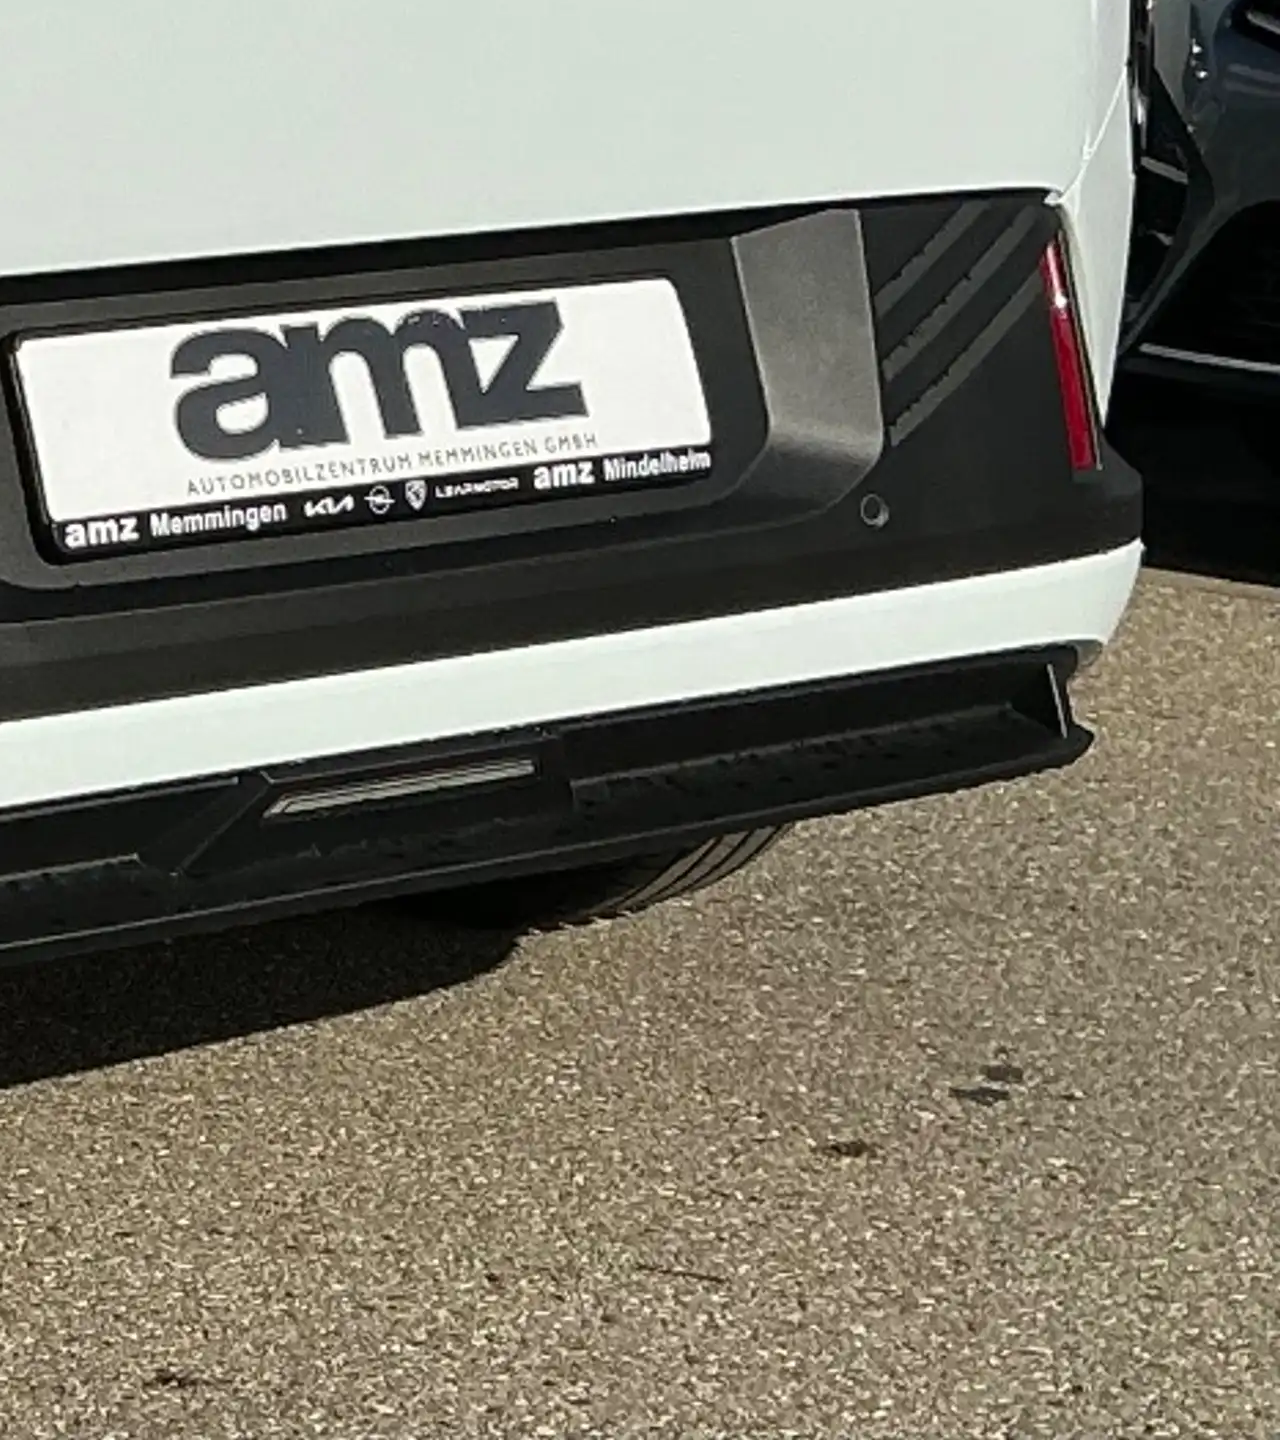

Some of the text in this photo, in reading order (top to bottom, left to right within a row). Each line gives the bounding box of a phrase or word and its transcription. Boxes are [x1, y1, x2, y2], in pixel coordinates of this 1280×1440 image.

[169, 298, 590, 462] amz
[65, 515, 140, 548] amz
[150, 502, 287, 536] Memmingen
[533, 459, 595, 489] amz
[602, 448, 711, 481] Mindelheim
[187, 433, 598, 496] AUTOMOBILZENTRUM MEMMINGEN GMBH
